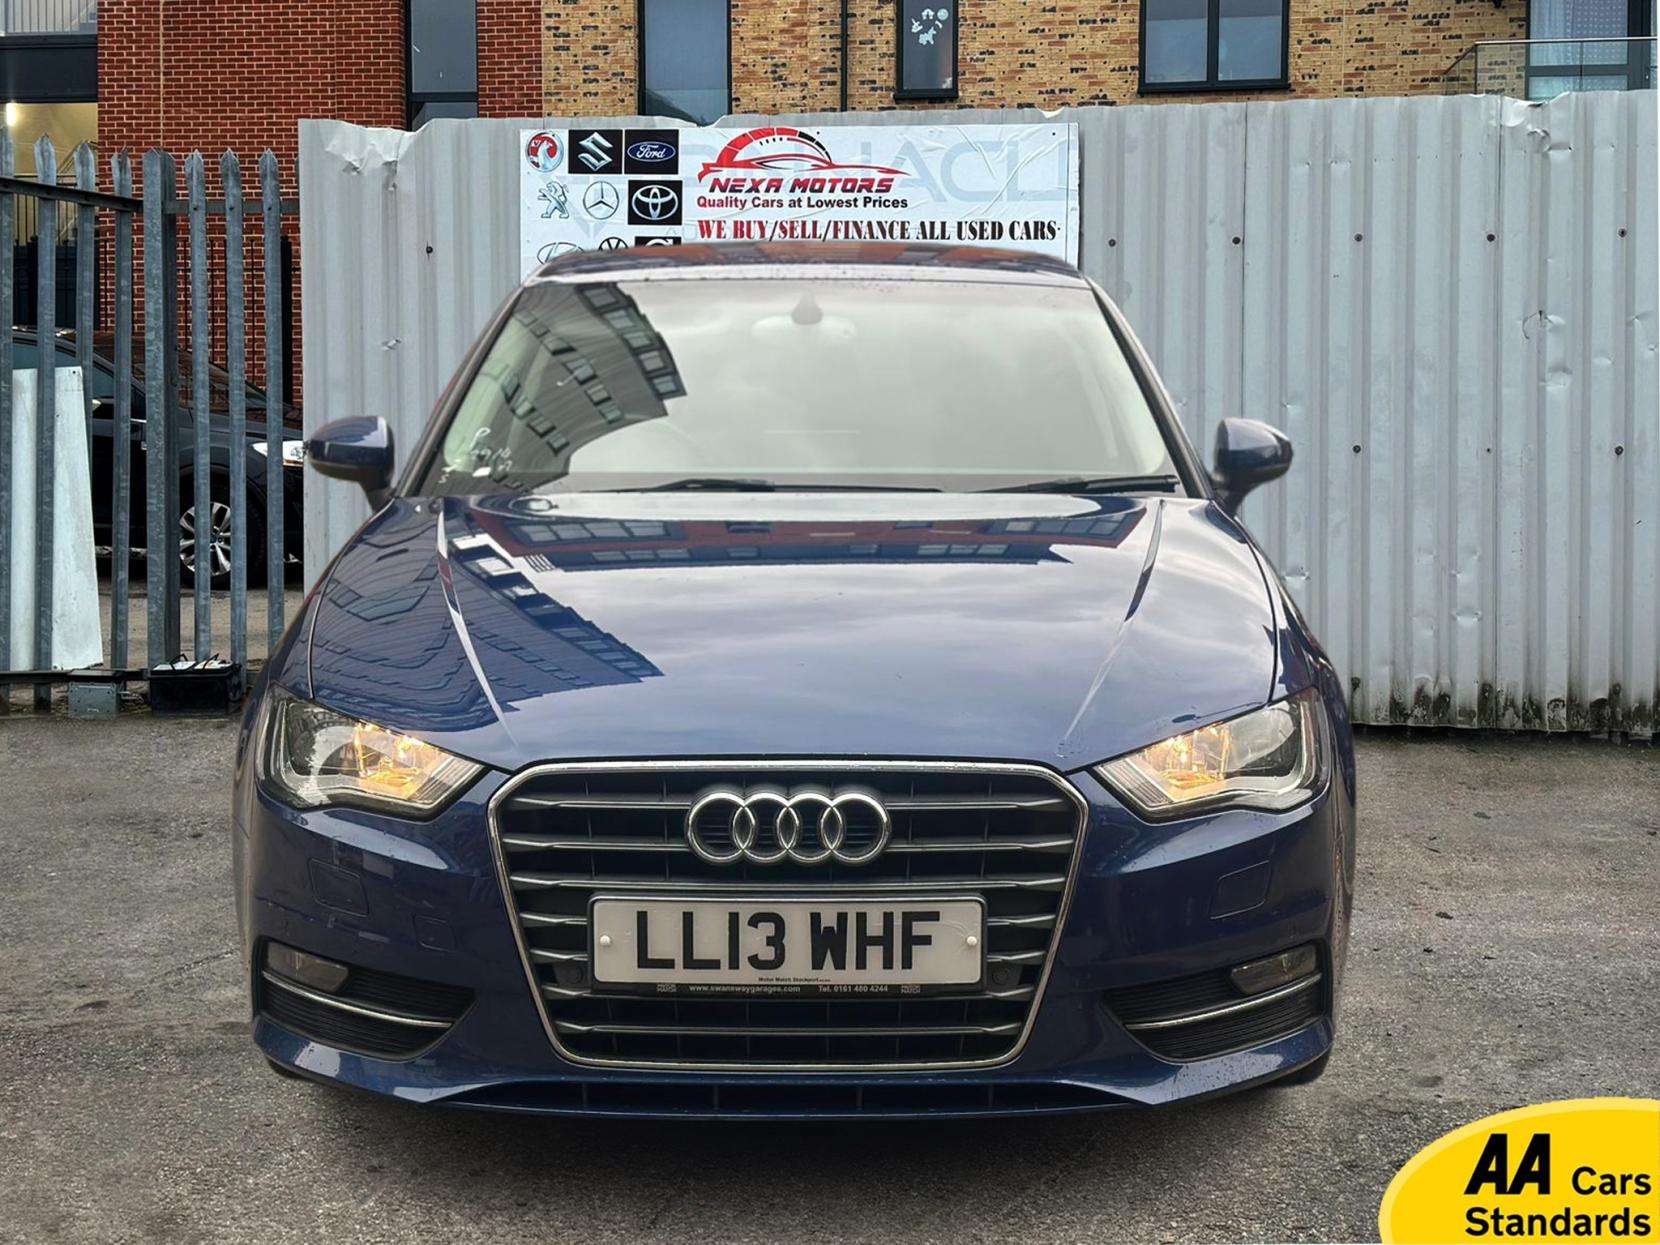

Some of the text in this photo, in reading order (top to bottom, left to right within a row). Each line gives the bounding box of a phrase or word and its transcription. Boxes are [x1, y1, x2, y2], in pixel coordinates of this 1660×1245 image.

[636, 144, 666, 158] Ford
[709, 178, 894, 193] NEXA MOTORS
[697, 196, 908, 210] Quality Cars at Lowest Prices
[697, 219, 726, 240] WE
[732, 219, 911, 243] BUY/SELL/FINANCE
[916, 220, 951, 241] ALL
[956, 220, 1004, 241] USED
[636, 910, 941, 970] LL13 WHF
